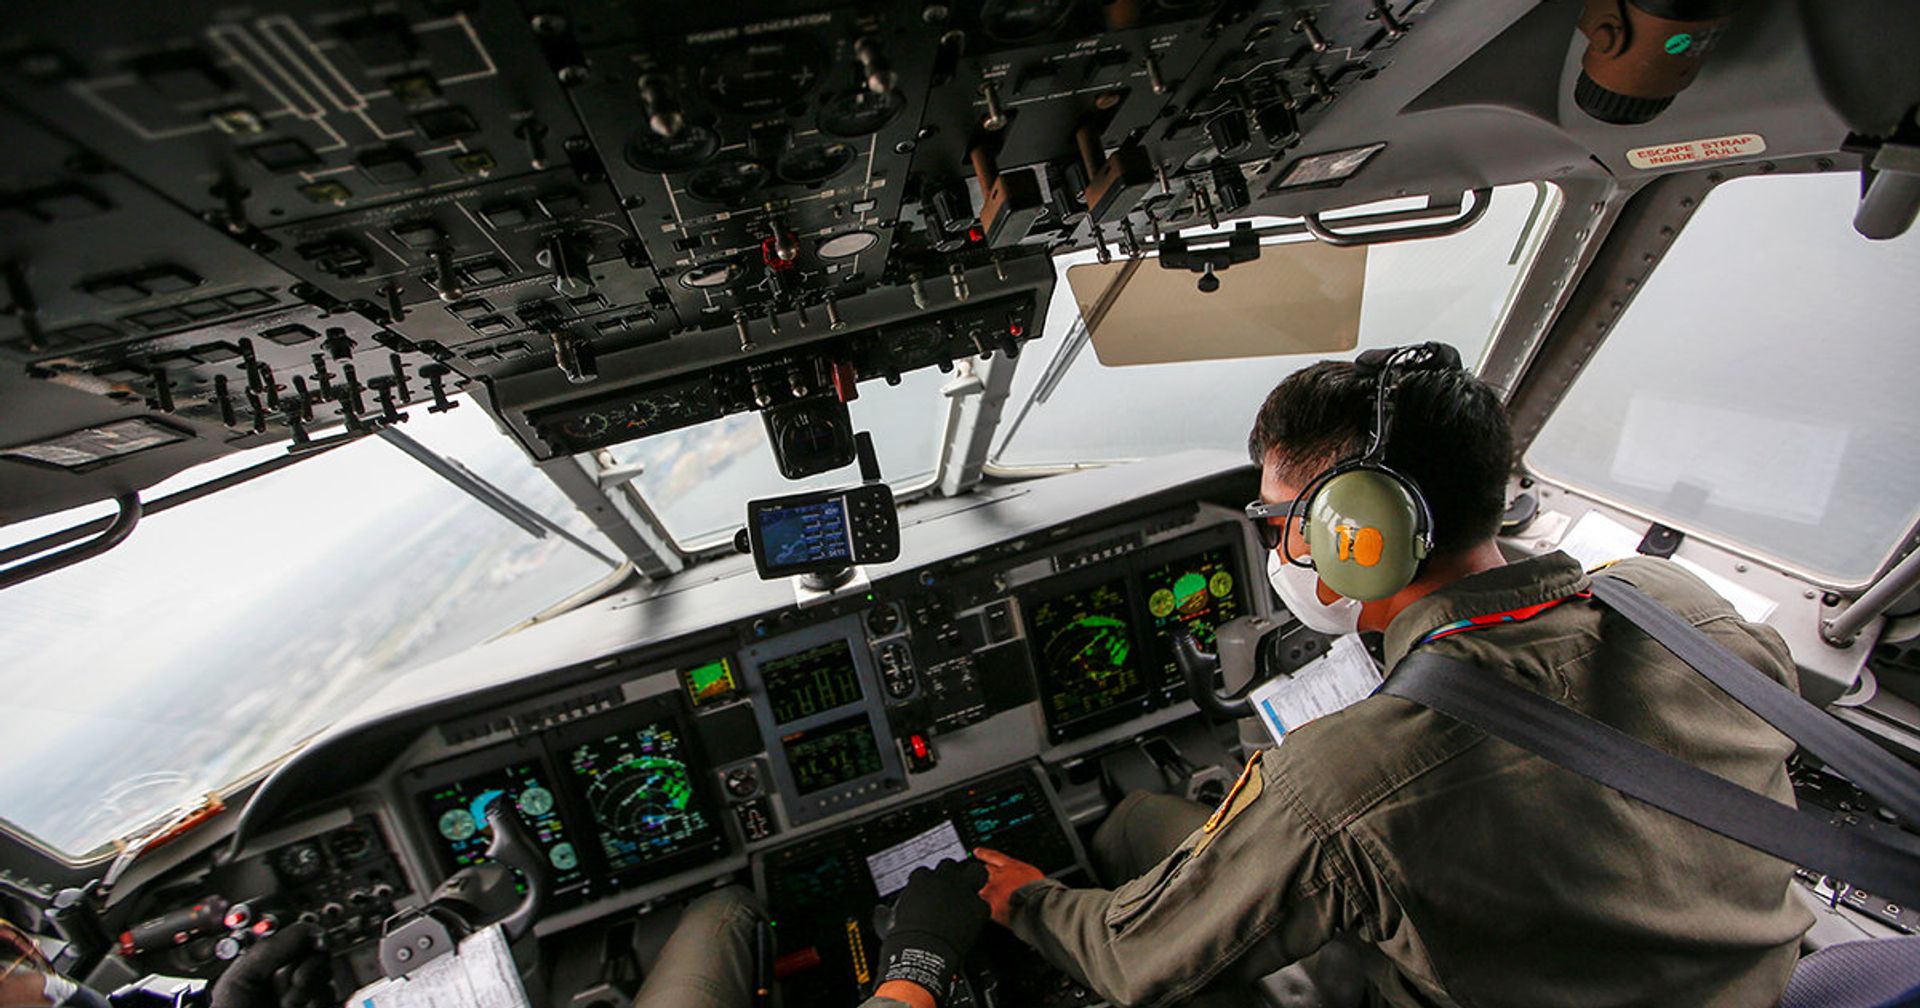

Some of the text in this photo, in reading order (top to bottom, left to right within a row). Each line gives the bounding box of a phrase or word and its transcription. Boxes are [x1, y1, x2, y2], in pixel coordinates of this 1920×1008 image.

[1637, 136, 1752, 158] ESCAPE STRAP
[1650, 147, 1743, 164] INSIDE PULL
